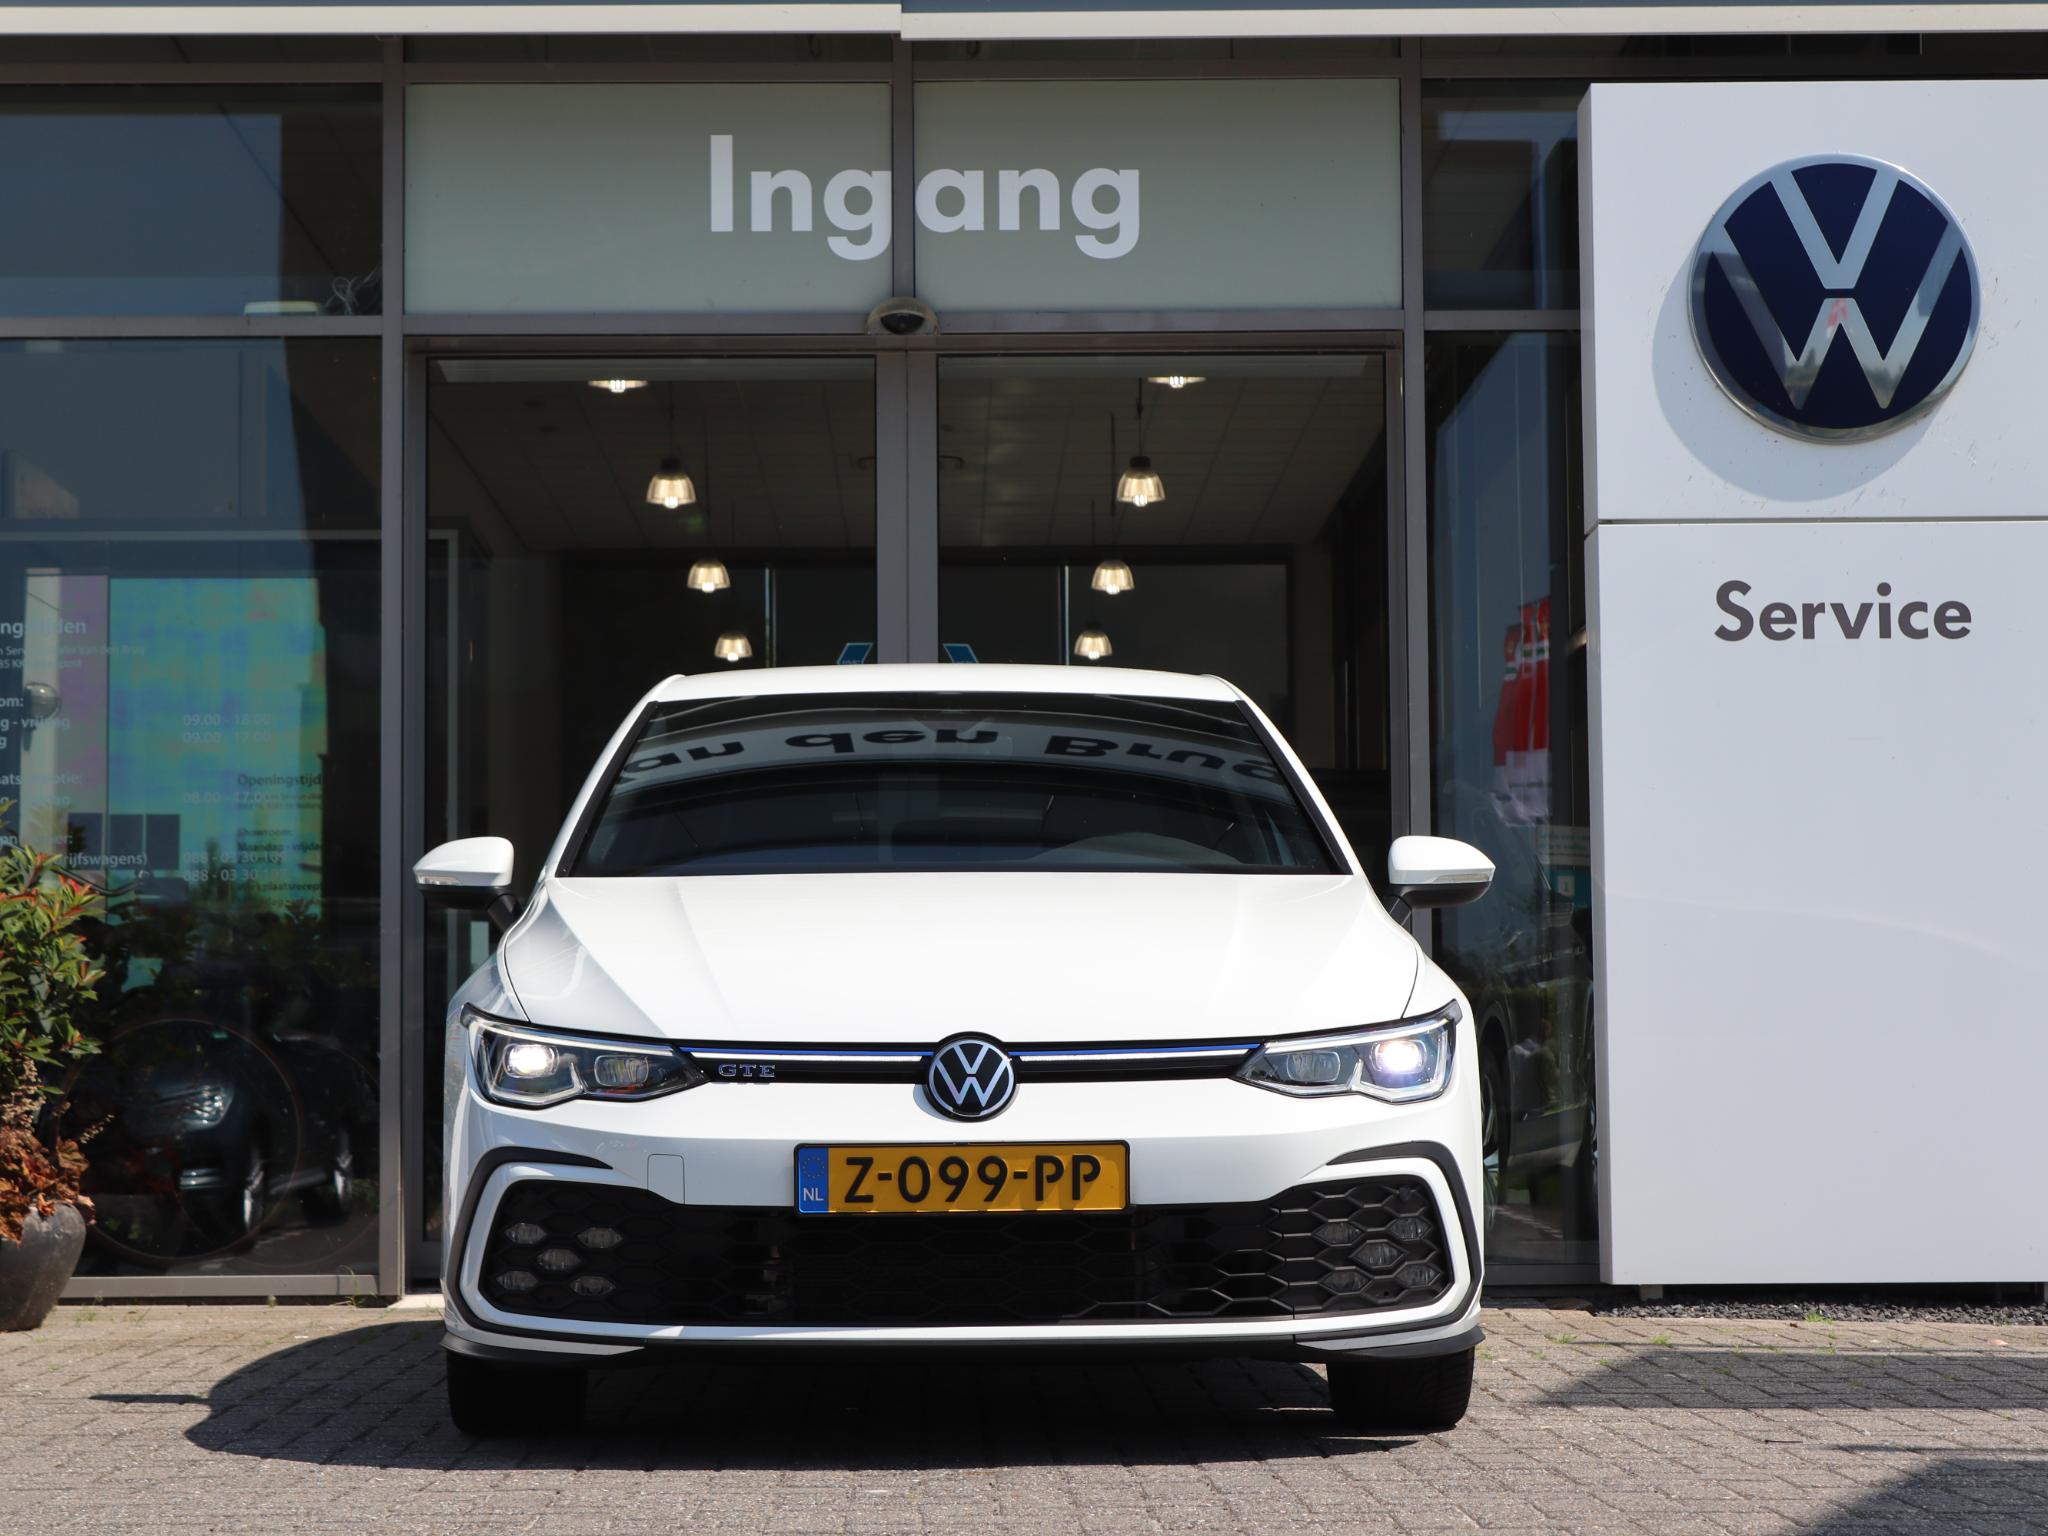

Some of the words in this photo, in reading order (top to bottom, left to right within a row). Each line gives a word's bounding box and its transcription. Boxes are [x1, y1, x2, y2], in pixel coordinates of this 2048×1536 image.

[710, 134, 1141, 261] Ingang
[1714, 579, 1972, 642] Service
[718, 1063, 776, 1078] GTE
[803, 1188, 824, 1202] NL
[844, 1154, 1101, 1204] Z-099-PP
